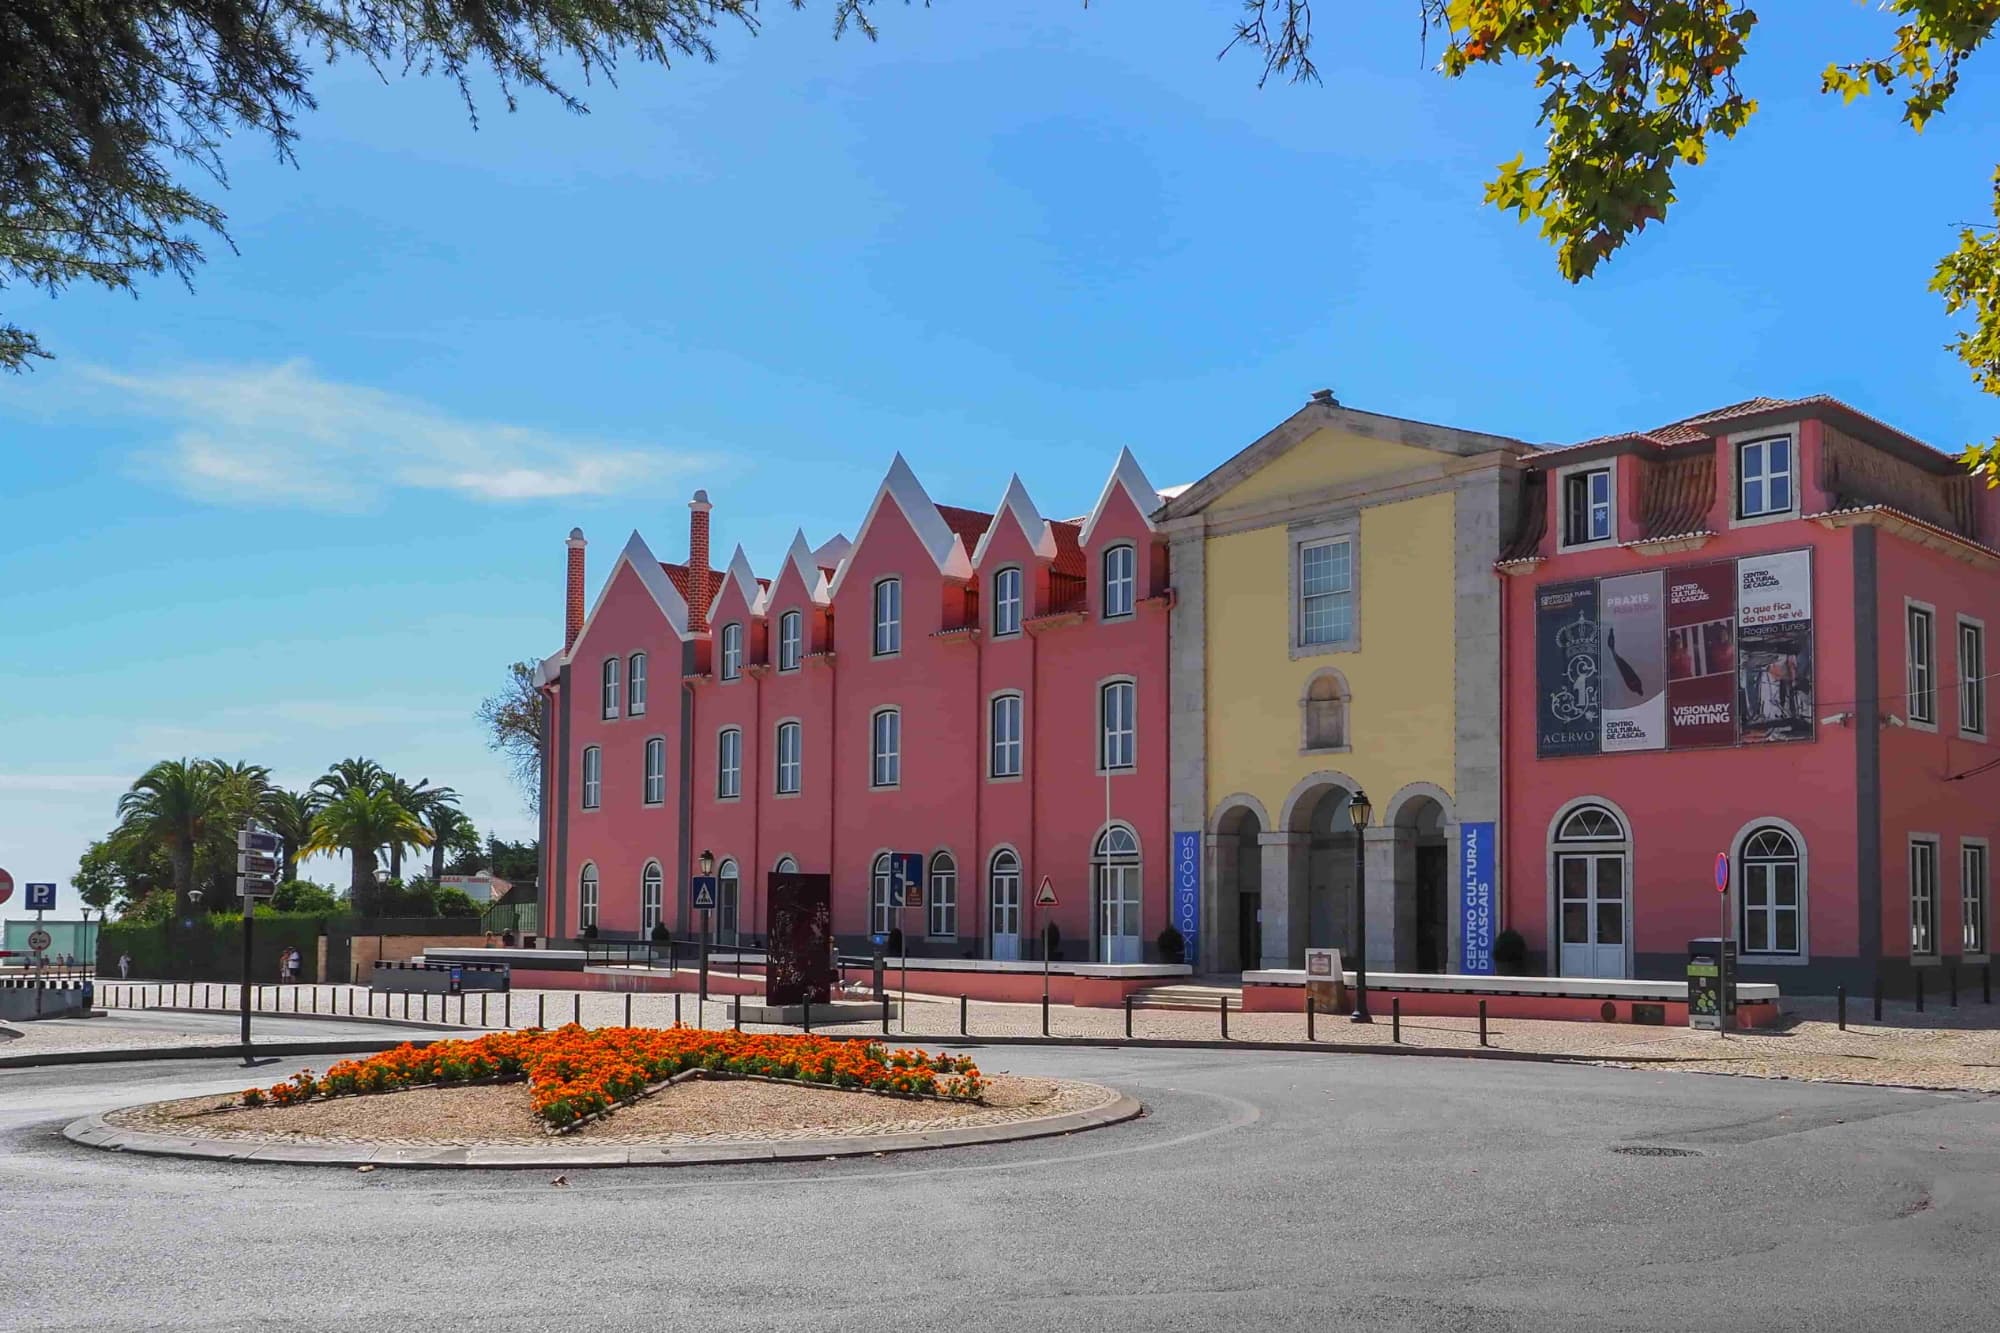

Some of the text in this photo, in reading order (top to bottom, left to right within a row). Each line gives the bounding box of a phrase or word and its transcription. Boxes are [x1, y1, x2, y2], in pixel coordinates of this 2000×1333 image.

[1743, 570, 1769, 578] CENTRO
[1743, 575, 1775, 584] CULTURAL
[1671, 583, 1698, 592] CENTRO
[1753, 580, 1780, 588] CASCAIS
[1671, 589, 1705, 598] CULTURAL
[1681, 594, 1709, 603] CASCAIS
[1607, 593, 1649, 608] PRAXIS
[1742, 602, 1792, 614] O que fica
[1742, 614, 1754, 623] do
[1757, 614, 1776, 624] que
[1792, 609, 1803, 618] vê
[1672, 703, 1730, 716] VISIONARY
[1673, 712, 1730, 727] WRITING
[1606, 726, 1641, 734] CULTURAL
[1617, 732, 1646, 740] CASCAIS
[1543, 730, 1594, 744] ACERVO
[33, 884, 49, 903] P
[1466, 829, 1477, 969] CENTRO CULTURAL
[1478, 883, 1488, 969] DE CASCAIS
